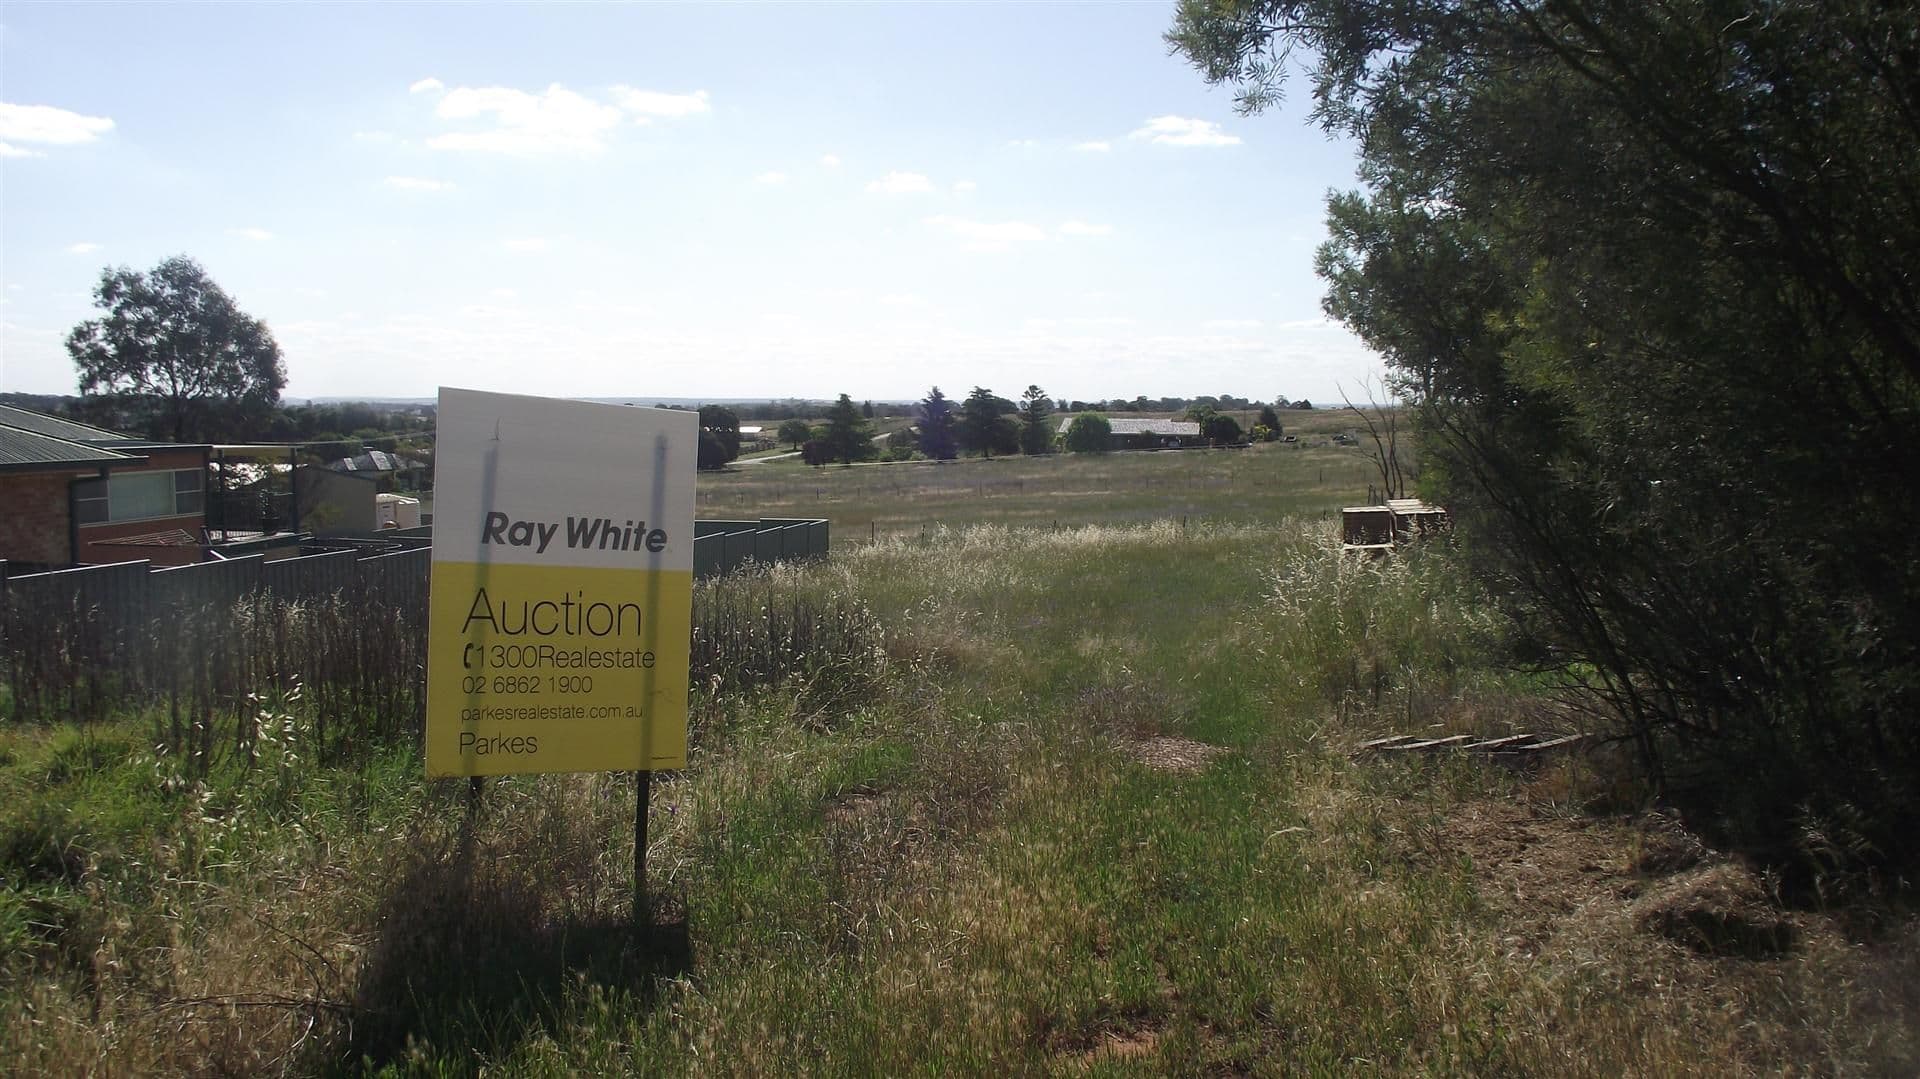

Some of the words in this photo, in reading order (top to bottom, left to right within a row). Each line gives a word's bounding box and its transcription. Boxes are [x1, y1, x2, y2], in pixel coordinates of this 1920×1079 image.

[481, 511, 559, 554] Ray
[566, 516, 668, 553] White
[461, 587, 642, 637] Auction
[476, 645, 656, 669] 1300Realestate
[462, 676, 486, 694] 02
[493, 676, 541, 694] 6862
[548, 676, 593, 694] 1900
[461, 704, 644, 724] parkesrealestate.com.au
[459, 732, 539, 755] Parkes
